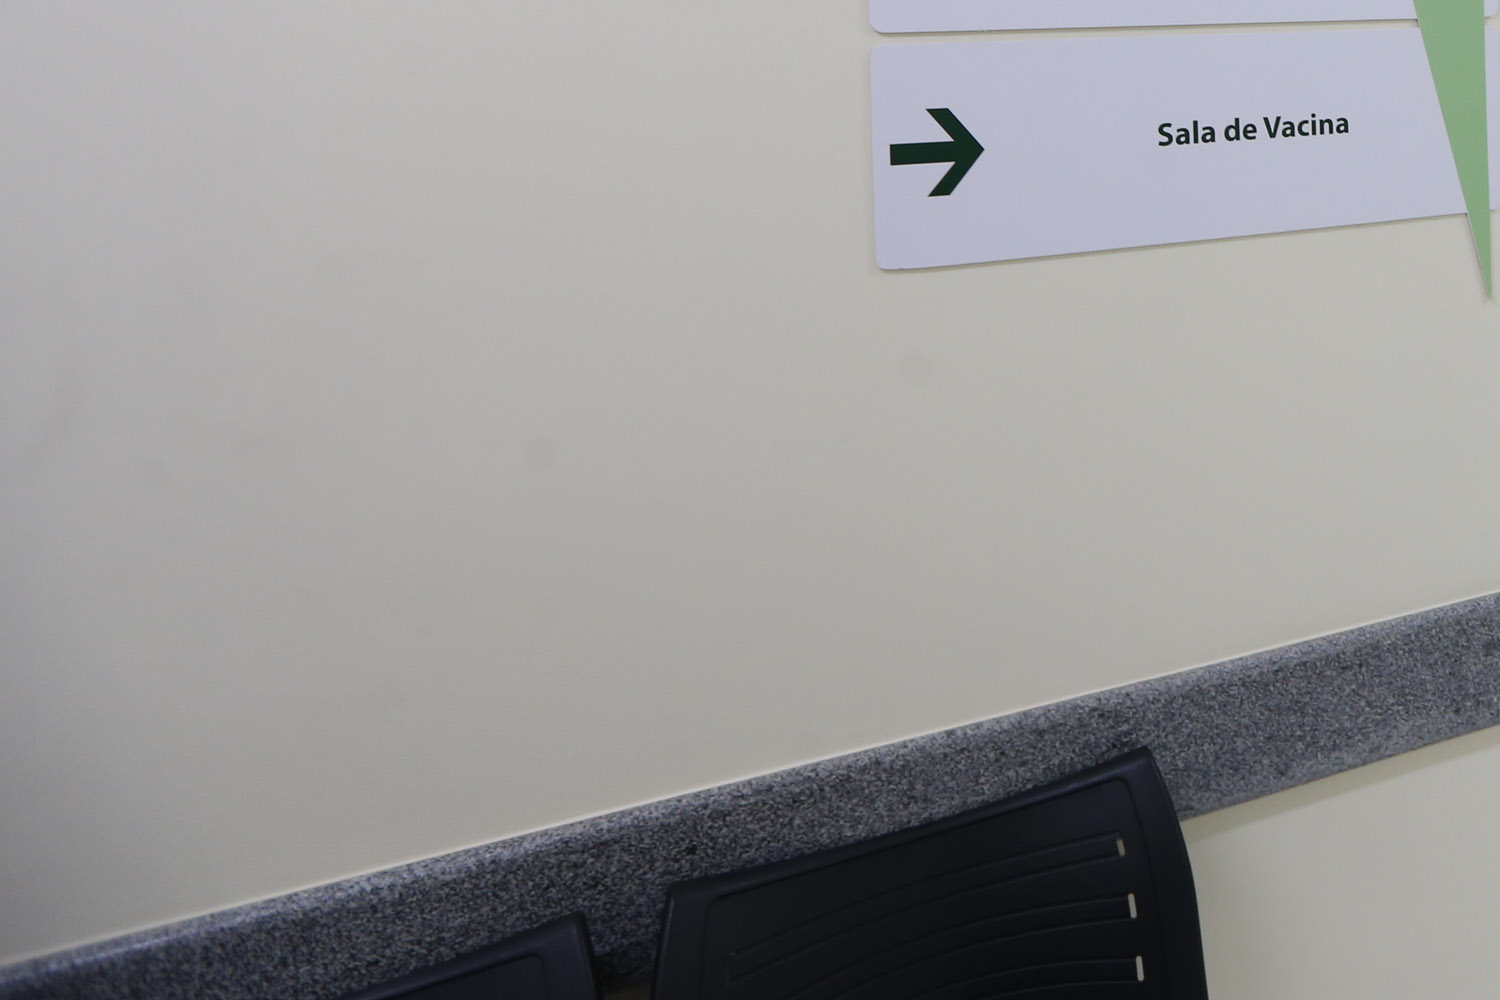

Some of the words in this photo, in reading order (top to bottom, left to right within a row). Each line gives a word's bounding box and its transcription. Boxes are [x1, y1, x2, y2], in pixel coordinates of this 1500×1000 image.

[1158, 120, 1215, 146] Sala
[1224, 118, 1257, 141] de
[1263, 113, 1348, 138] Vacina
